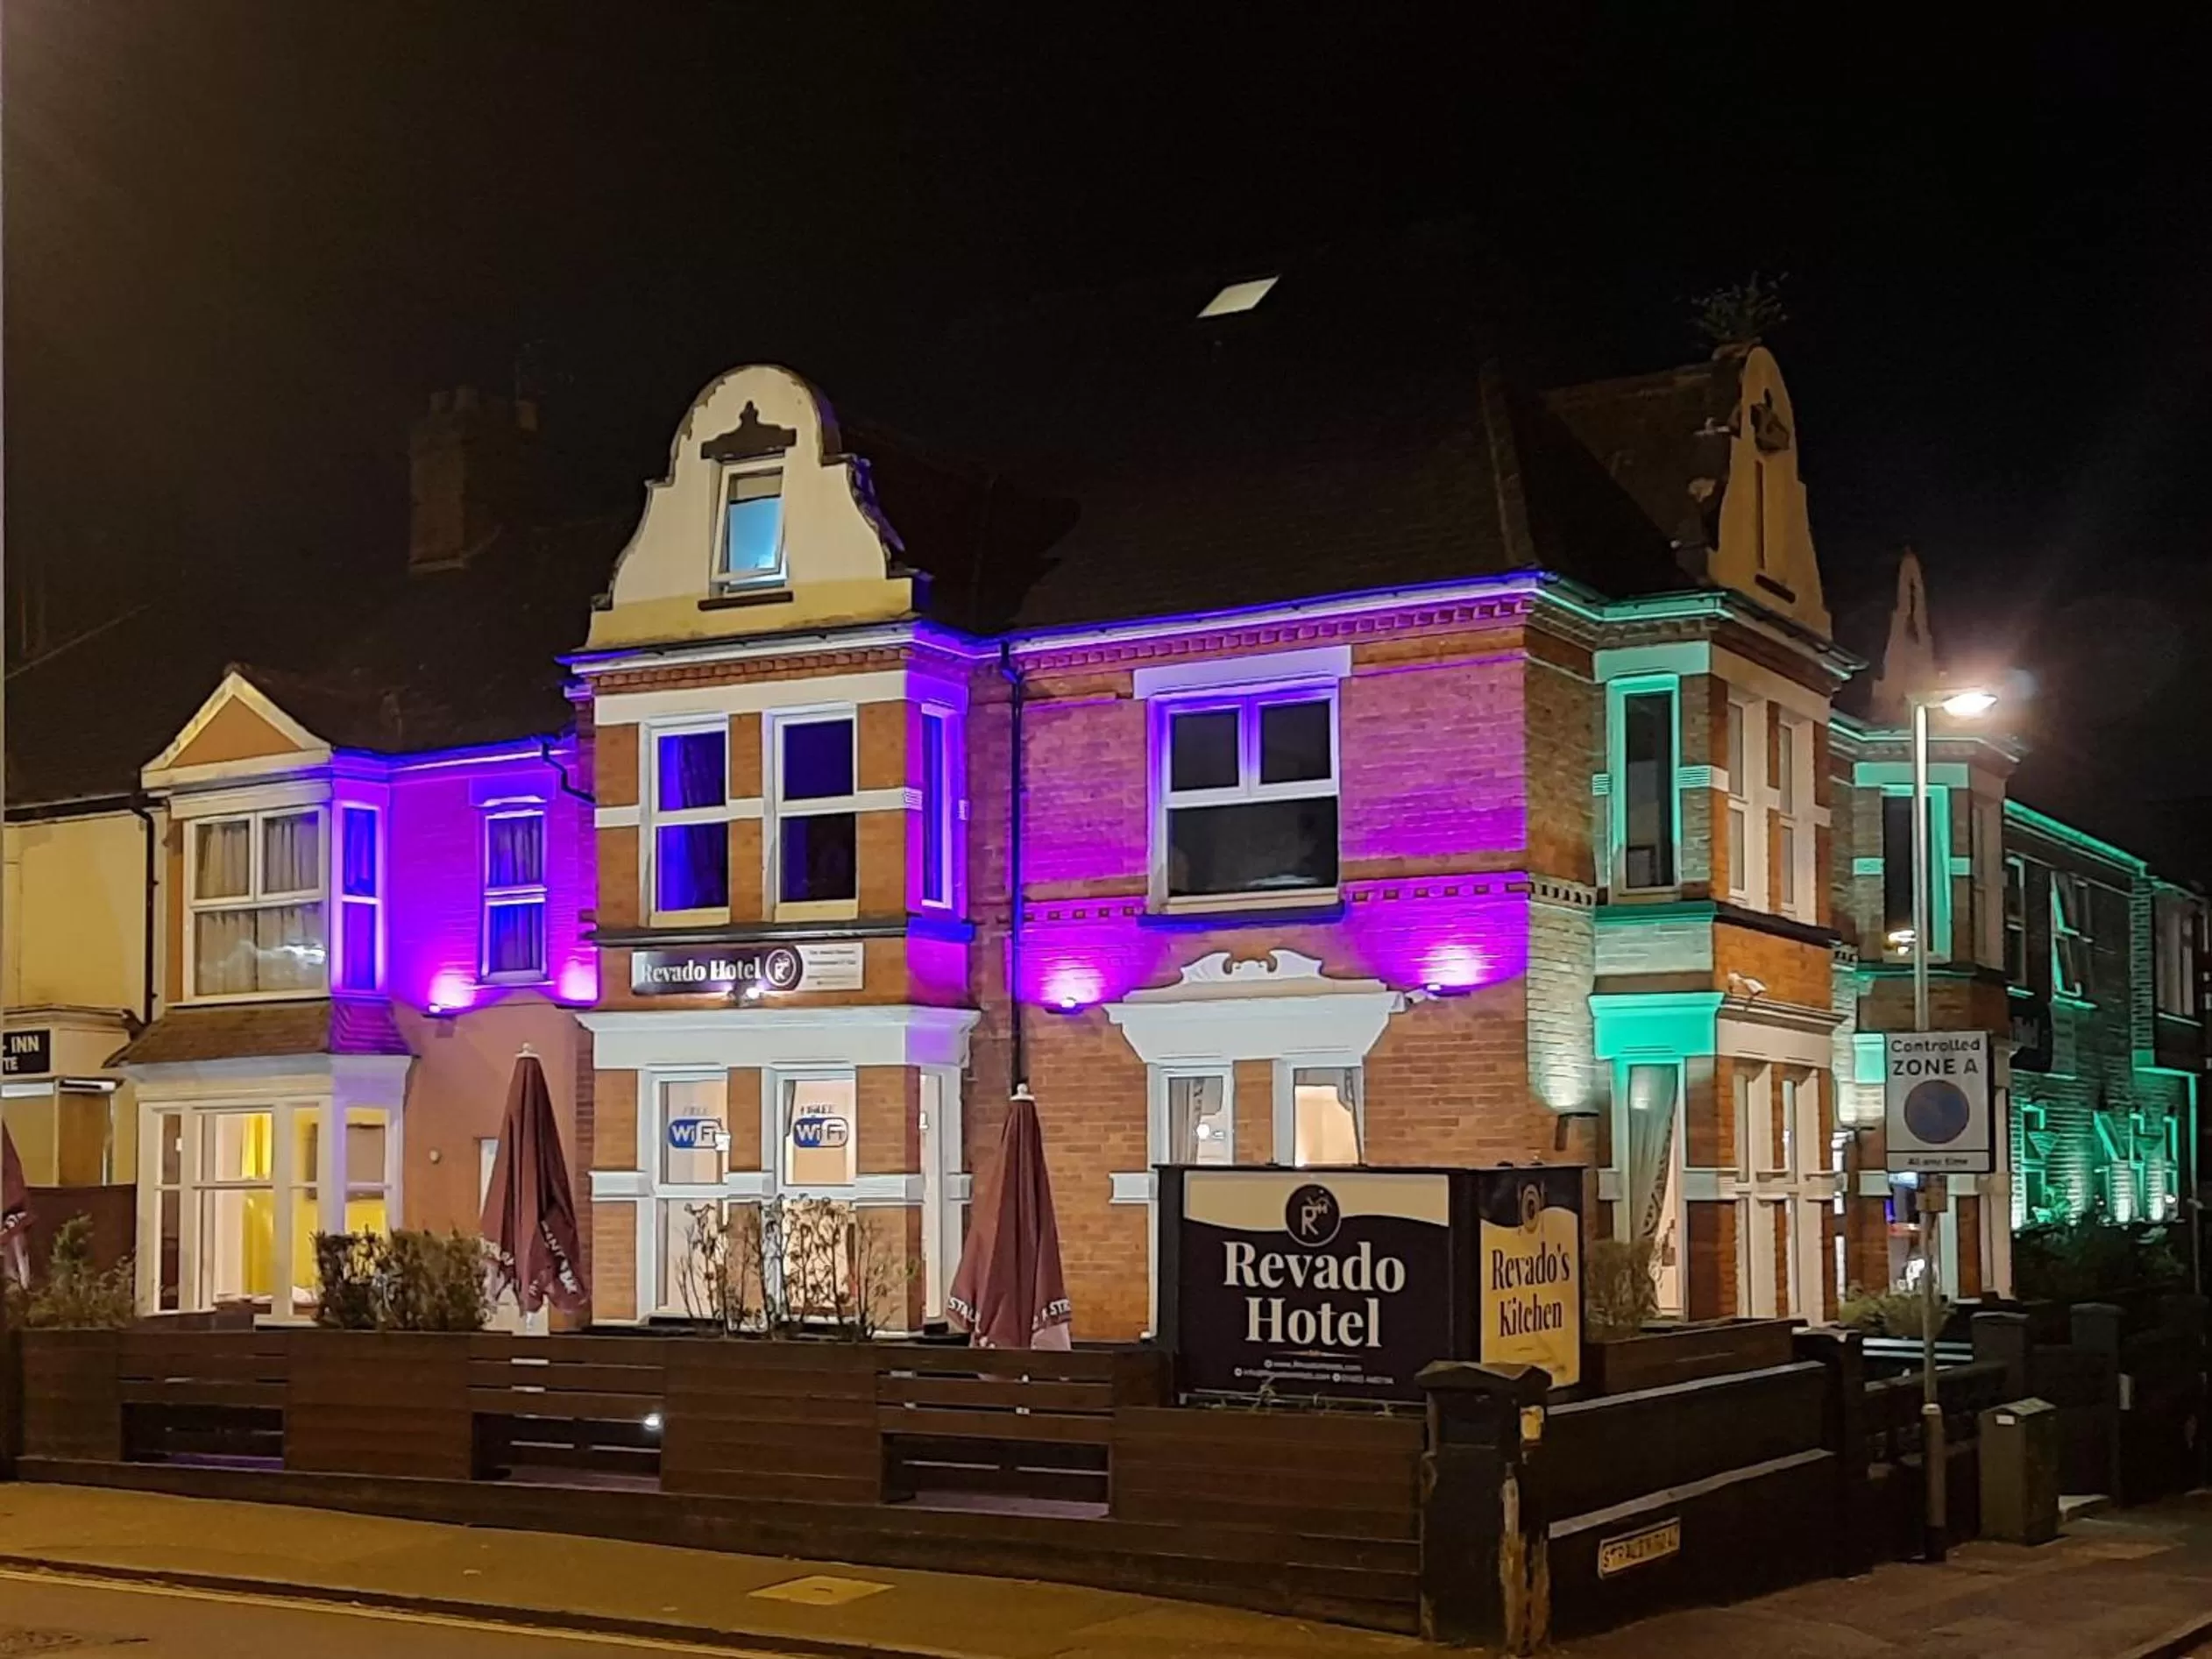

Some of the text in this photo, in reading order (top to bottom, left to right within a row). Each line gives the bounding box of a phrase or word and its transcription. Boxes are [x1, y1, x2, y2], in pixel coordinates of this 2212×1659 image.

[710, 956, 762, 981] Hotel
[11, 1035, 39, 1053] INN
[1891, 1039, 1981, 1053] Controlled
[1893, 1058, 1979, 1076] ZONE A
[1223, 1240, 1406, 1293] Revado
[1492, 1240, 1570, 1291] Revado's
[1244, 1297, 1382, 1348] Hotel
[1499, 1294, 1563, 1337] Kitchen
